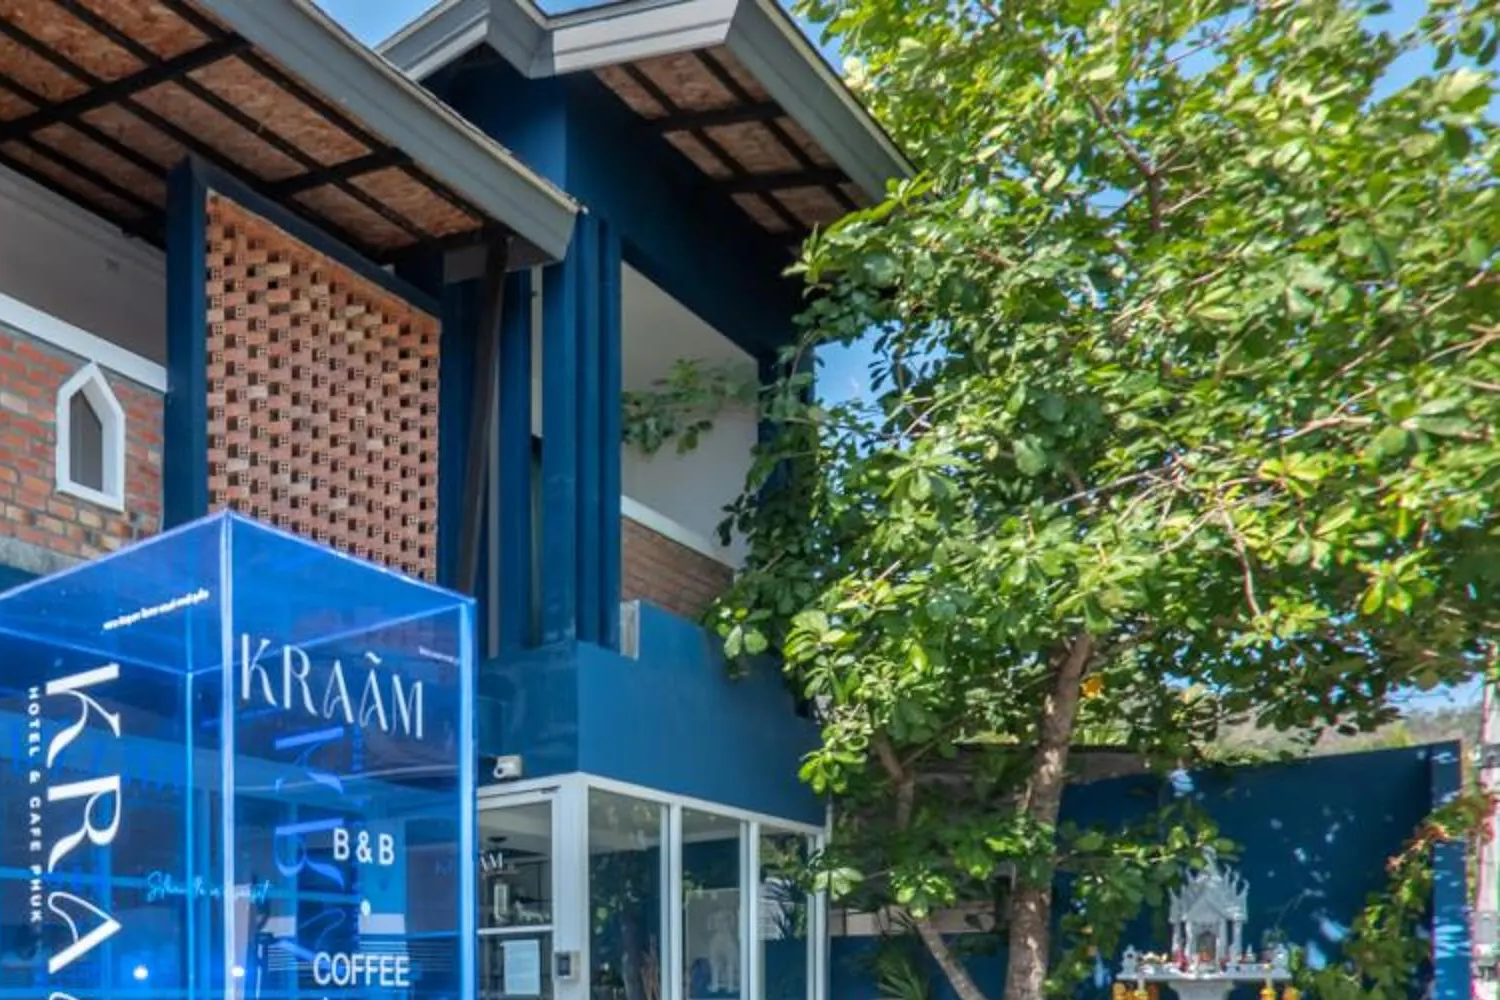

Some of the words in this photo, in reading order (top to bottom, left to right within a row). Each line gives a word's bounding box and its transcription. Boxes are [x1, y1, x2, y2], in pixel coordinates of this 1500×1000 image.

[27, 686, 41, 757] HOTEL
[28, 795, 42, 852] CAFE
[313, 952, 410, 987] COFFEE
